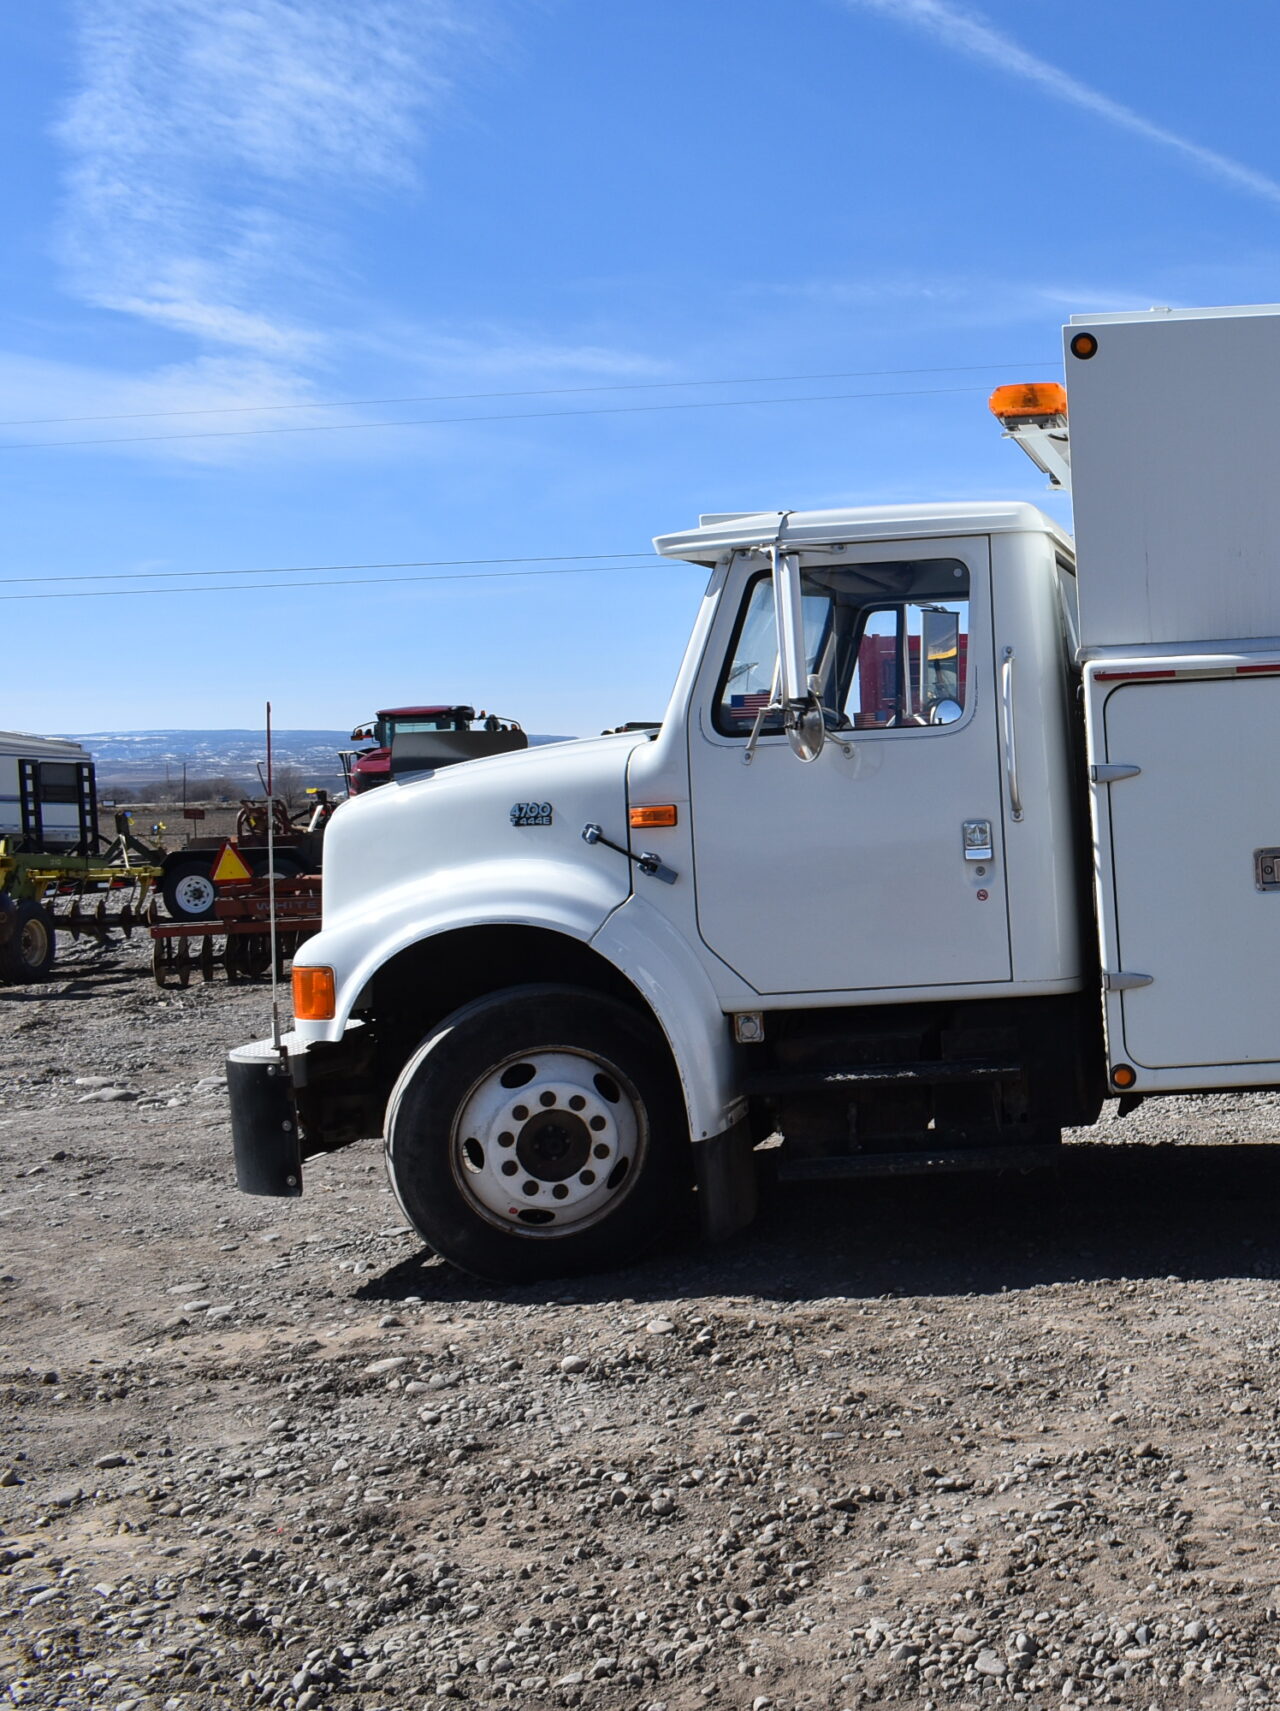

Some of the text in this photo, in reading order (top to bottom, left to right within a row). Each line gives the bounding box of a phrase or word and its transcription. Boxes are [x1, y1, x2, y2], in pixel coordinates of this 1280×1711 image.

[510, 802, 552, 817] 4700
[520, 817, 551, 825] 444E
[256, 901, 318, 910] WHITE
